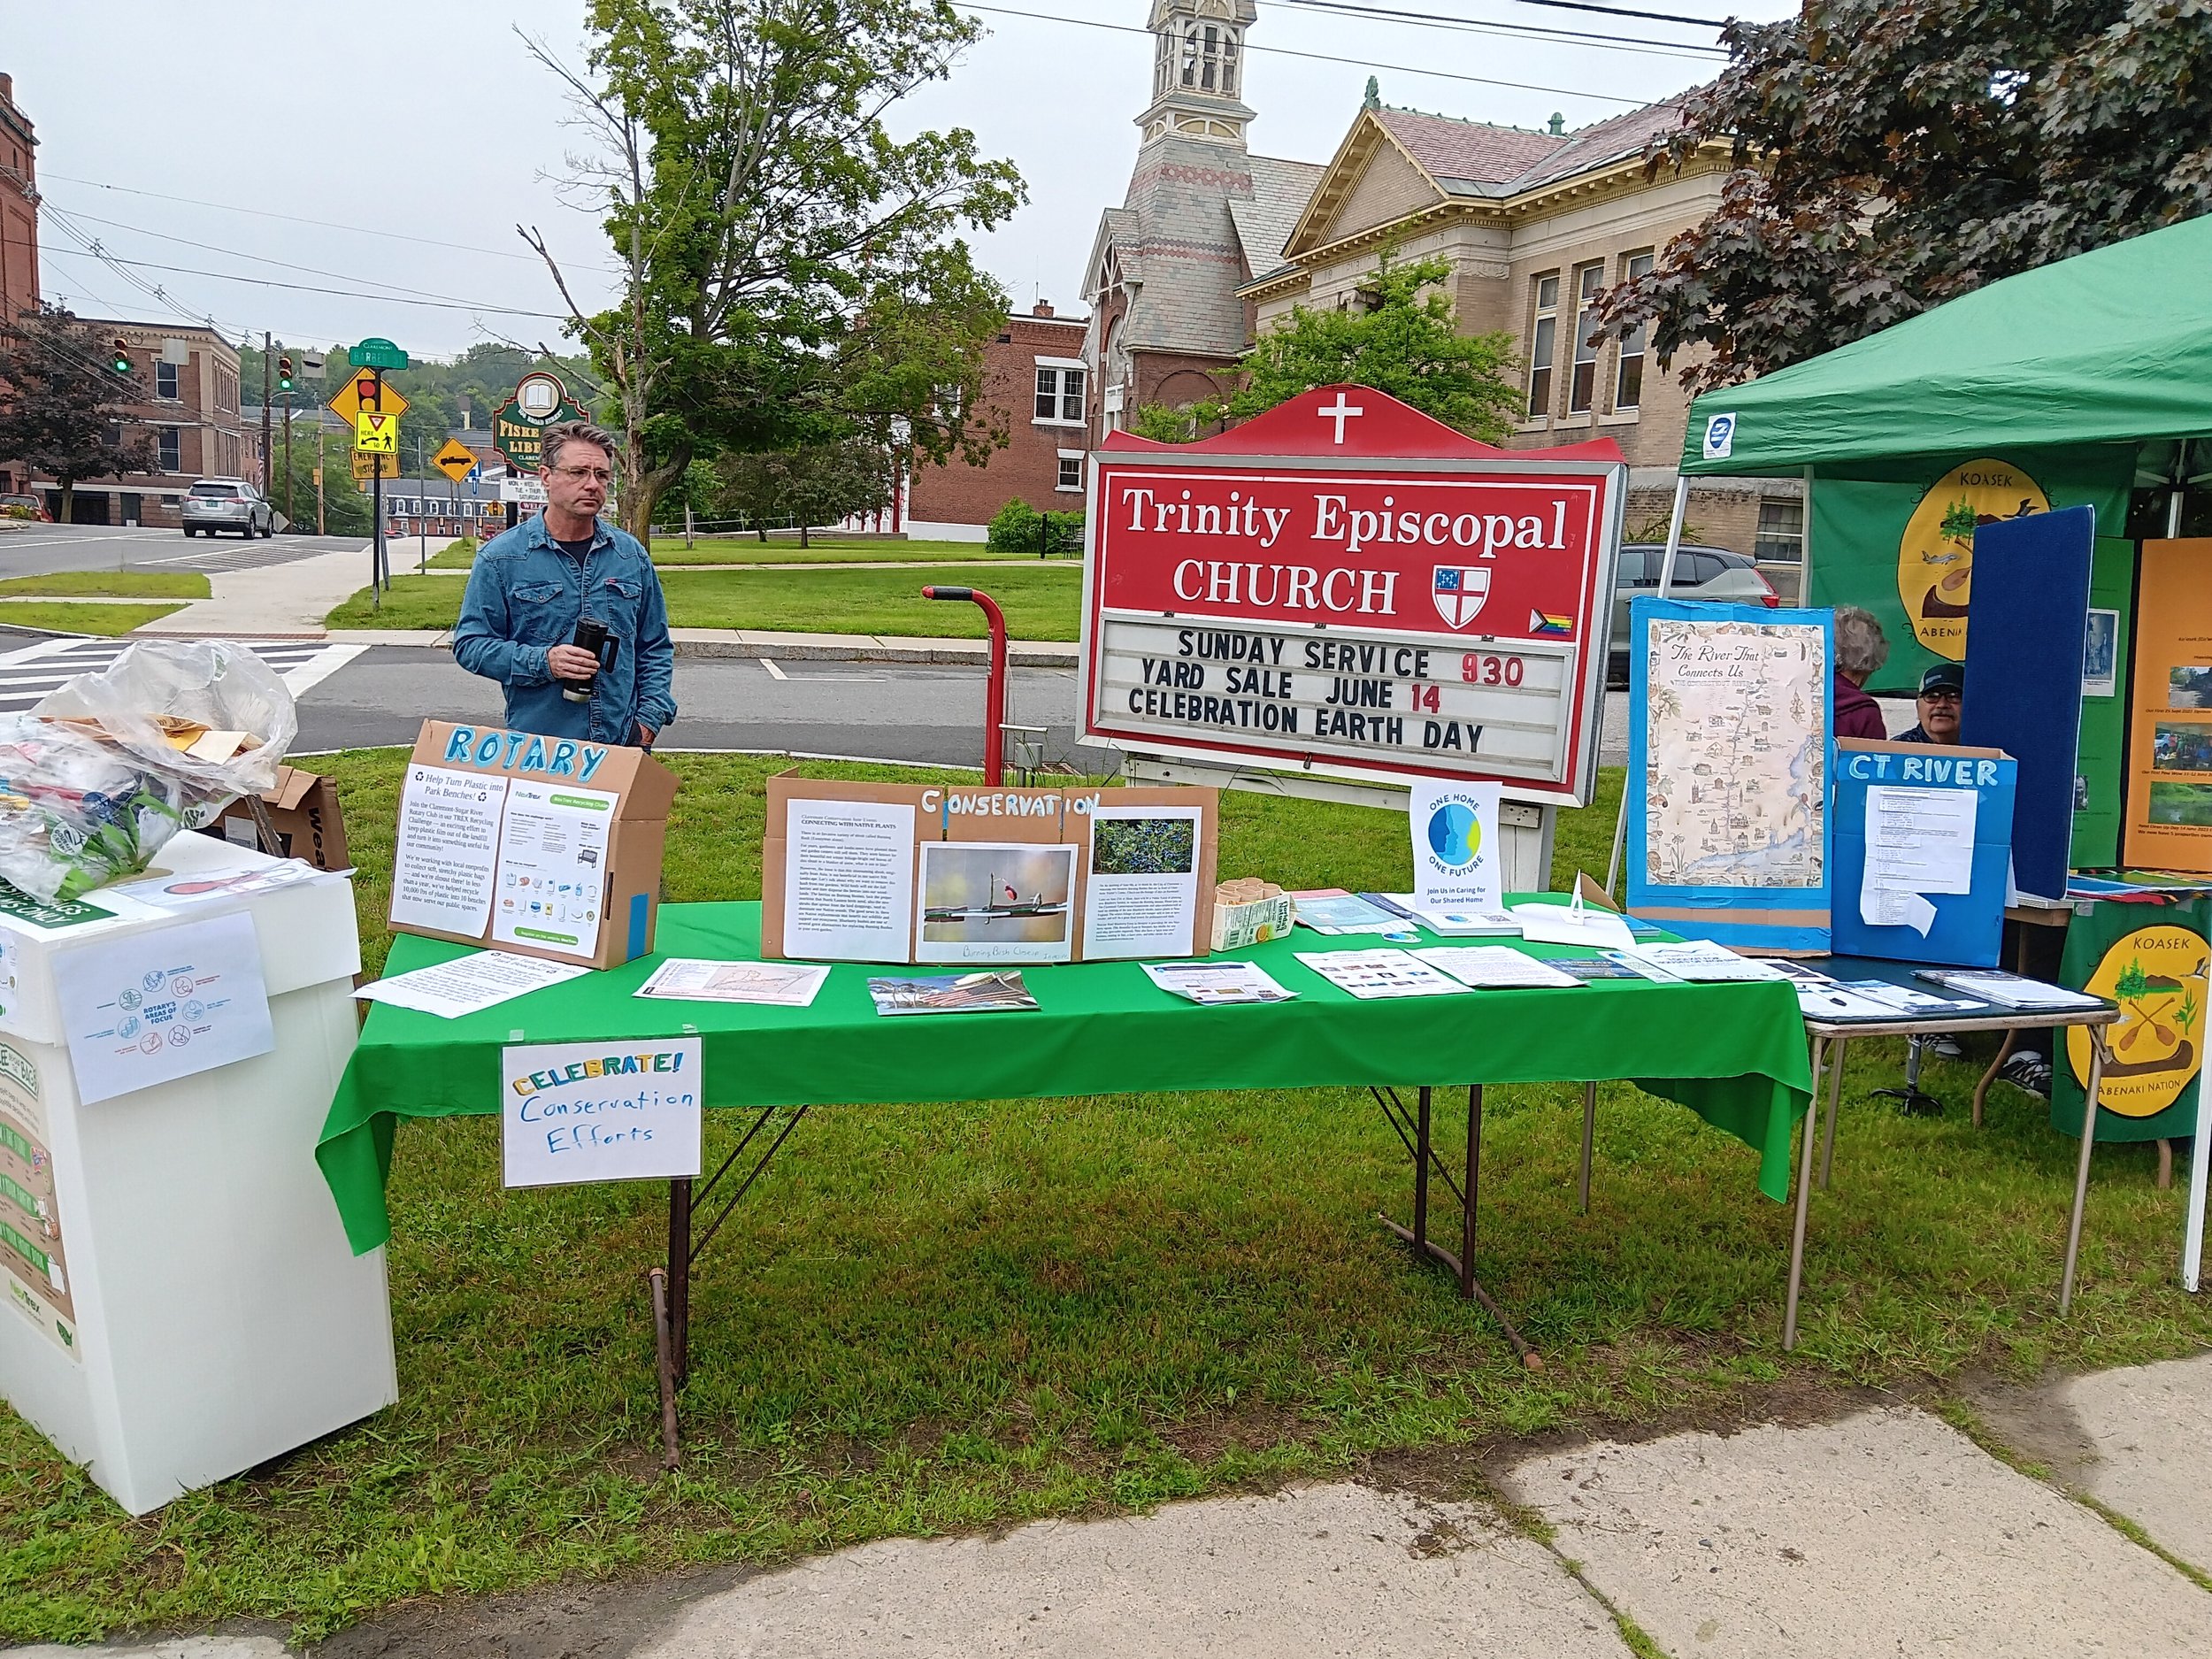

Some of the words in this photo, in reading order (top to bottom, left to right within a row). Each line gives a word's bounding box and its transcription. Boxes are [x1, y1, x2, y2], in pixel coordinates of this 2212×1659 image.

[499, 419, 539, 438] FISKE
[363, 464, 387, 473] SIGAL
[1959, 471, 2013, 488] KOASEK
[1122, 488, 1292, 548] Trinity
[1310, 494, 1568, 559] Episcopal
[1172, 558, 1400, 615] CHURCH
[1178, 630, 1285, 665] SUNDAY
[1304, 641, 1430, 678] SERVICE
[1461, 654, 1524, 687] 930
[1671, 644, 1692, 661] The
[1698, 645, 1733, 662] River
[1734, 645, 1759, 661] That
[1678, 664, 1723, 677] Connects
[1727, 664, 1744, 677] Us
[1142, 658, 1205, 689] YARD
[1226, 667, 1292, 699] SALE
[1325, 676, 1393, 708] JUNE
[1411, 684, 1440, 714] 14
[1128, 687, 1297, 734] CELEBRATION
[1315, 707, 1403, 746] EARTH
[1424, 721, 1484, 753] DAY
[444, 724, 608, 783] ROTARY
[1848, 754, 1892, 779] CT
[1902, 757, 1998, 786] RIVER
[426, 774, 443, 786] Help
[464, 779, 487, 790] Plastic
[489, 782, 504, 791] into
[425, 786, 441, 796] Park
[443, 788, 476, 800] Benches!
[921, 789, 1100, 817] CONSERVATION
[1429, 794, 1450, 811] ONE
[1453, 794, 1480, 811] HOME
[1429, 856, 1447, 875] ONE
[1449, 855, 1484, 876] FUTURE
[15, 906, 73, 923] ONLY
[2132, 936, 2191, 951] KOASEK
[143, 1001, 176, 1013] ROTARY'S
[145, 1010, 167, 1020] AREAS
[167, 1007, 177, 1015] OF
[151, 1015, 173, 1025] FOCUS
[512, 1052, 684, 1096] CELEBRATE!
[2098, 1084, 2145, 1096] ABENAKI
[2147, 1079, 2181, 1092] NATION
[520, 1091, 693, 1122] Conservation
[547, 1124, 653, 1154] Efforts
